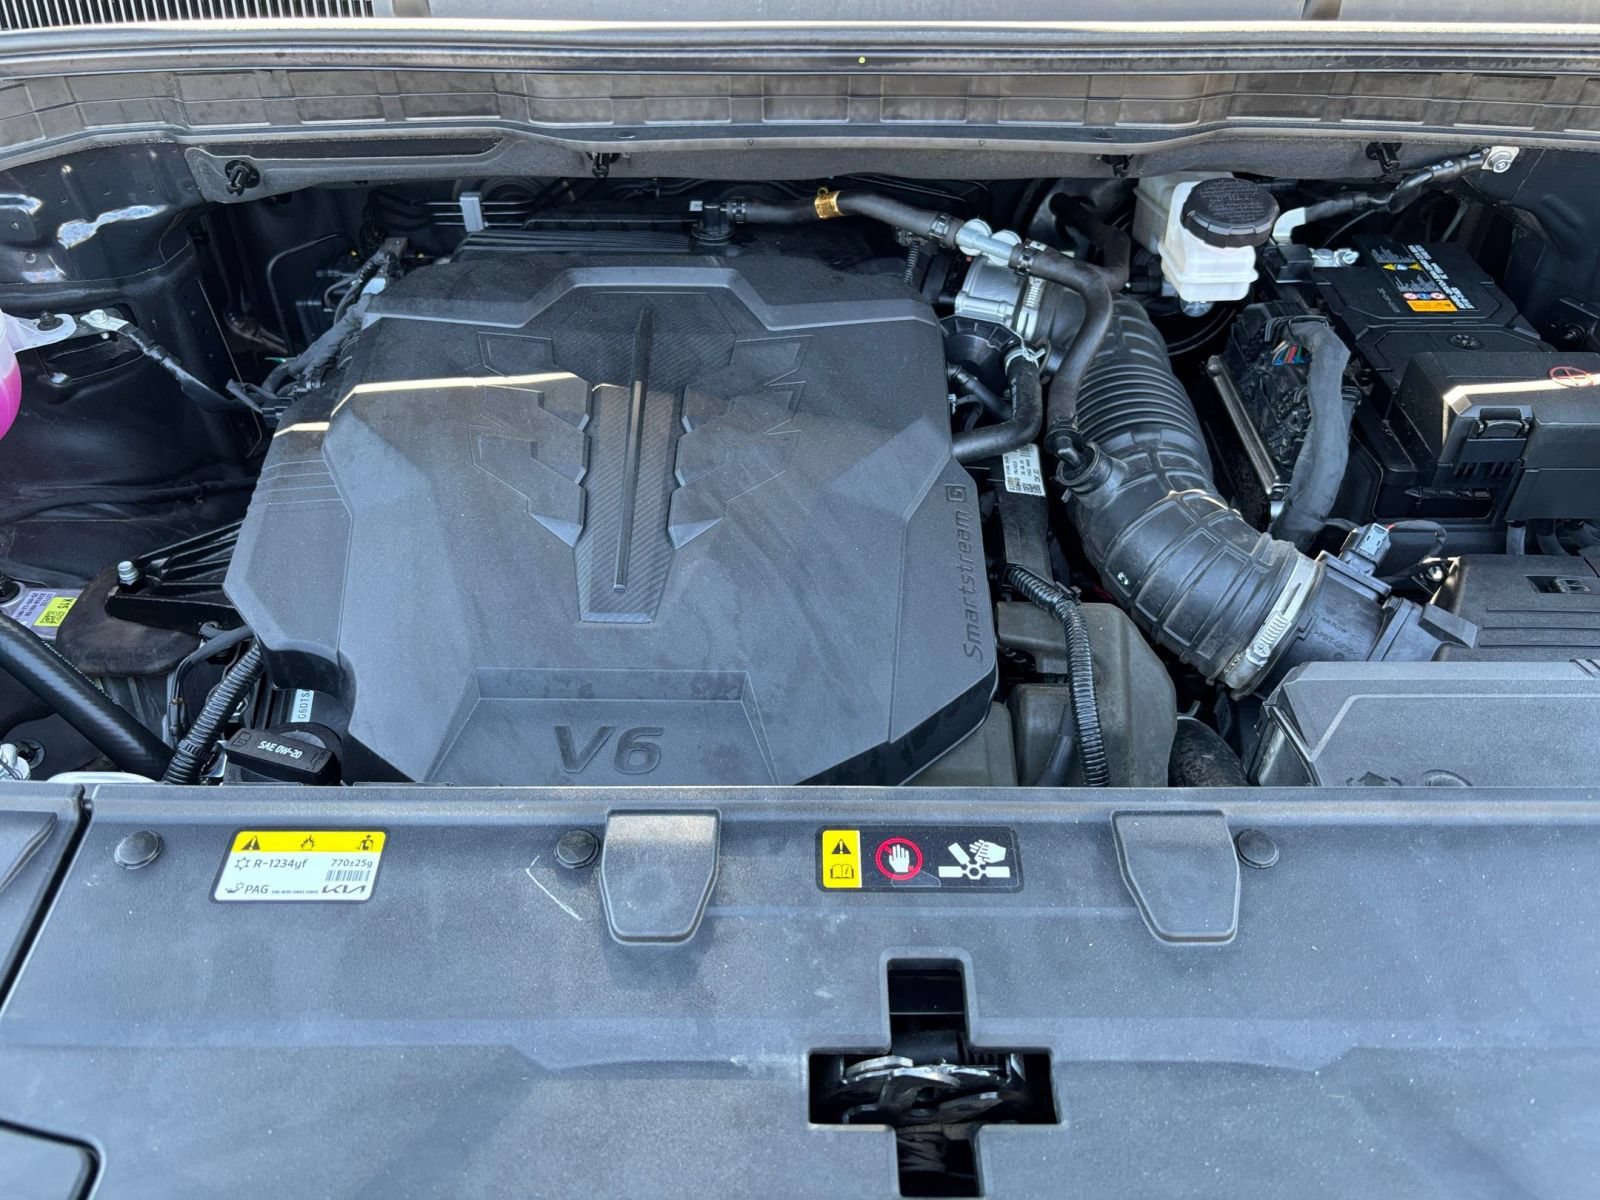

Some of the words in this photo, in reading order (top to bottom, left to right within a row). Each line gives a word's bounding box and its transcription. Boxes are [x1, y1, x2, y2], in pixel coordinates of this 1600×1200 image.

[956, 510, 984, 661] Smartstream
[297, 689, 310, 720] G6DTS
[257, 741, 275, 753] SAE
[274, 746, 303, 759] 0W-20
[554, 725, 665, 774] V6
[253, 859, 308, 869] R-1234yf
[331, 859, 373, 868] 770±25g
[244, 885, 269, 894] PAG
[321, 884, 366, 894] KIA
